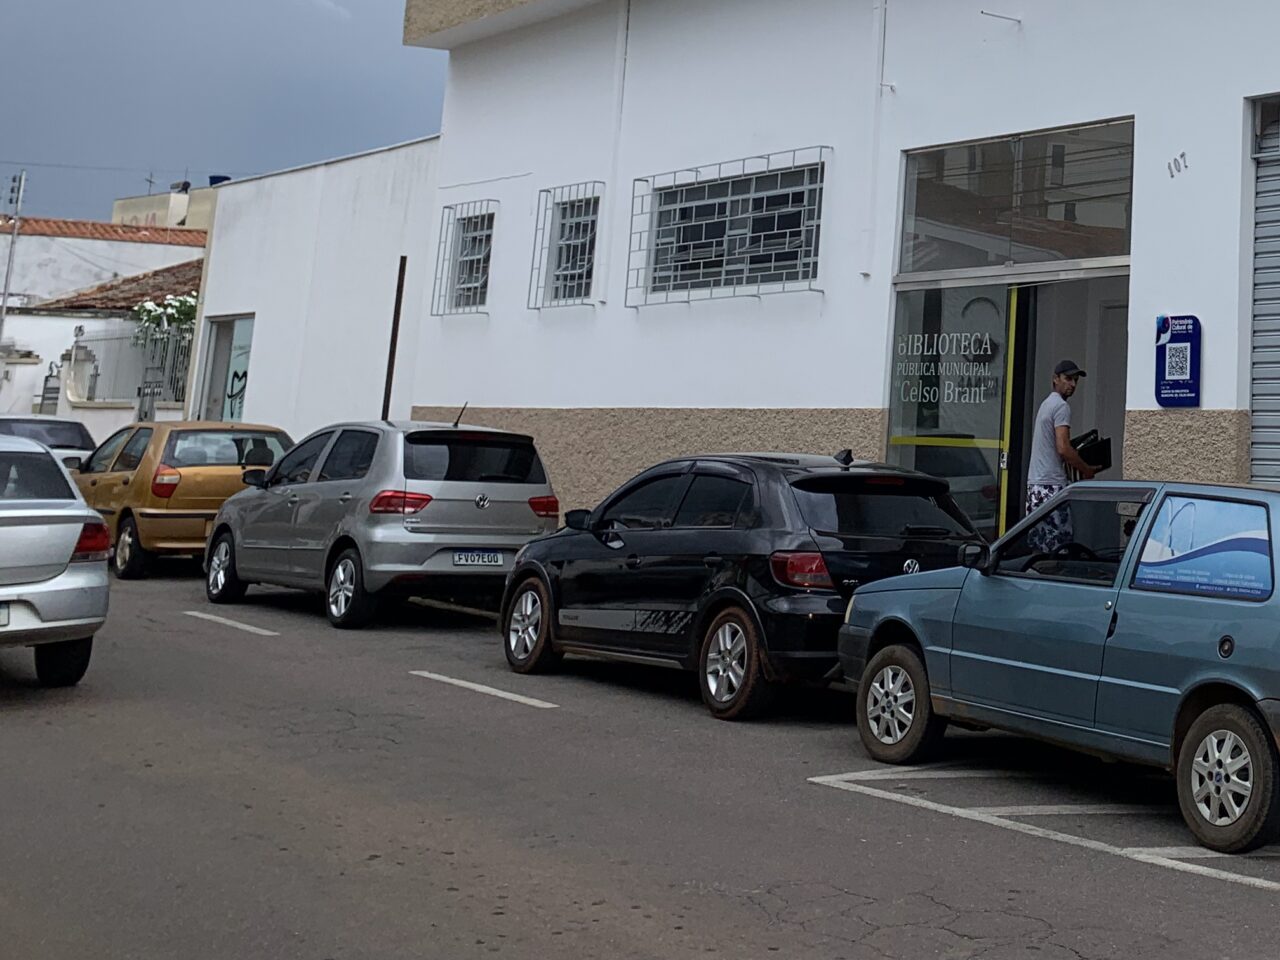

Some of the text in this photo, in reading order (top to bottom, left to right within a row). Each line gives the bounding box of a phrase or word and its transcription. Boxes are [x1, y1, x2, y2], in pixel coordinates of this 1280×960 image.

[1167, 151, 1189, 178] 107
[898, 332, 992, 356] BIBLIOTECA
[937, 361, 991, 376] MUNICIPAL
[944, 380, 994, 404] Brant”
